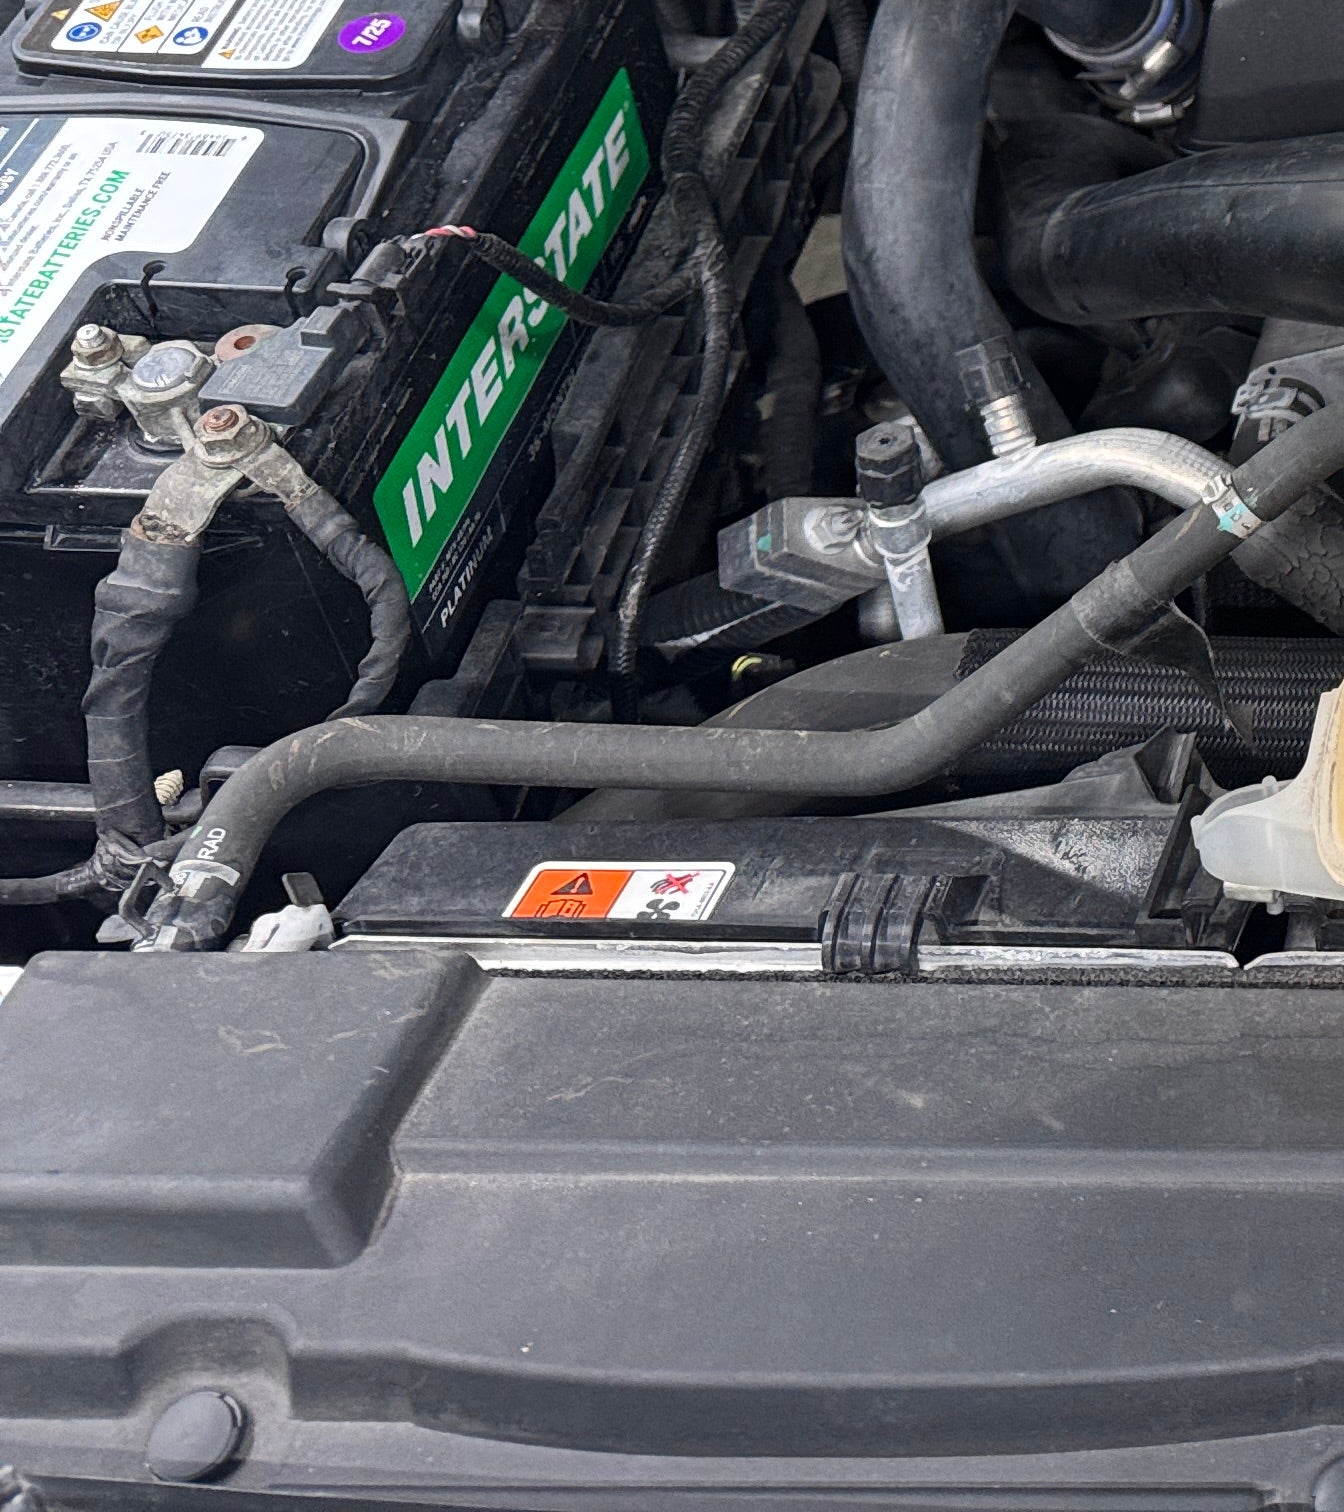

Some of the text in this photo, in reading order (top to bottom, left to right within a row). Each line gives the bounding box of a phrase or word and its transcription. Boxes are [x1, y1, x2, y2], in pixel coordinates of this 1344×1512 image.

[352, 18, 392, 47] 7/25
[114, 190, 158, 242] MAINTENANCE
[440, 524, 494, 629] PLATINUM
[197, 827, 227, 860] RAD
